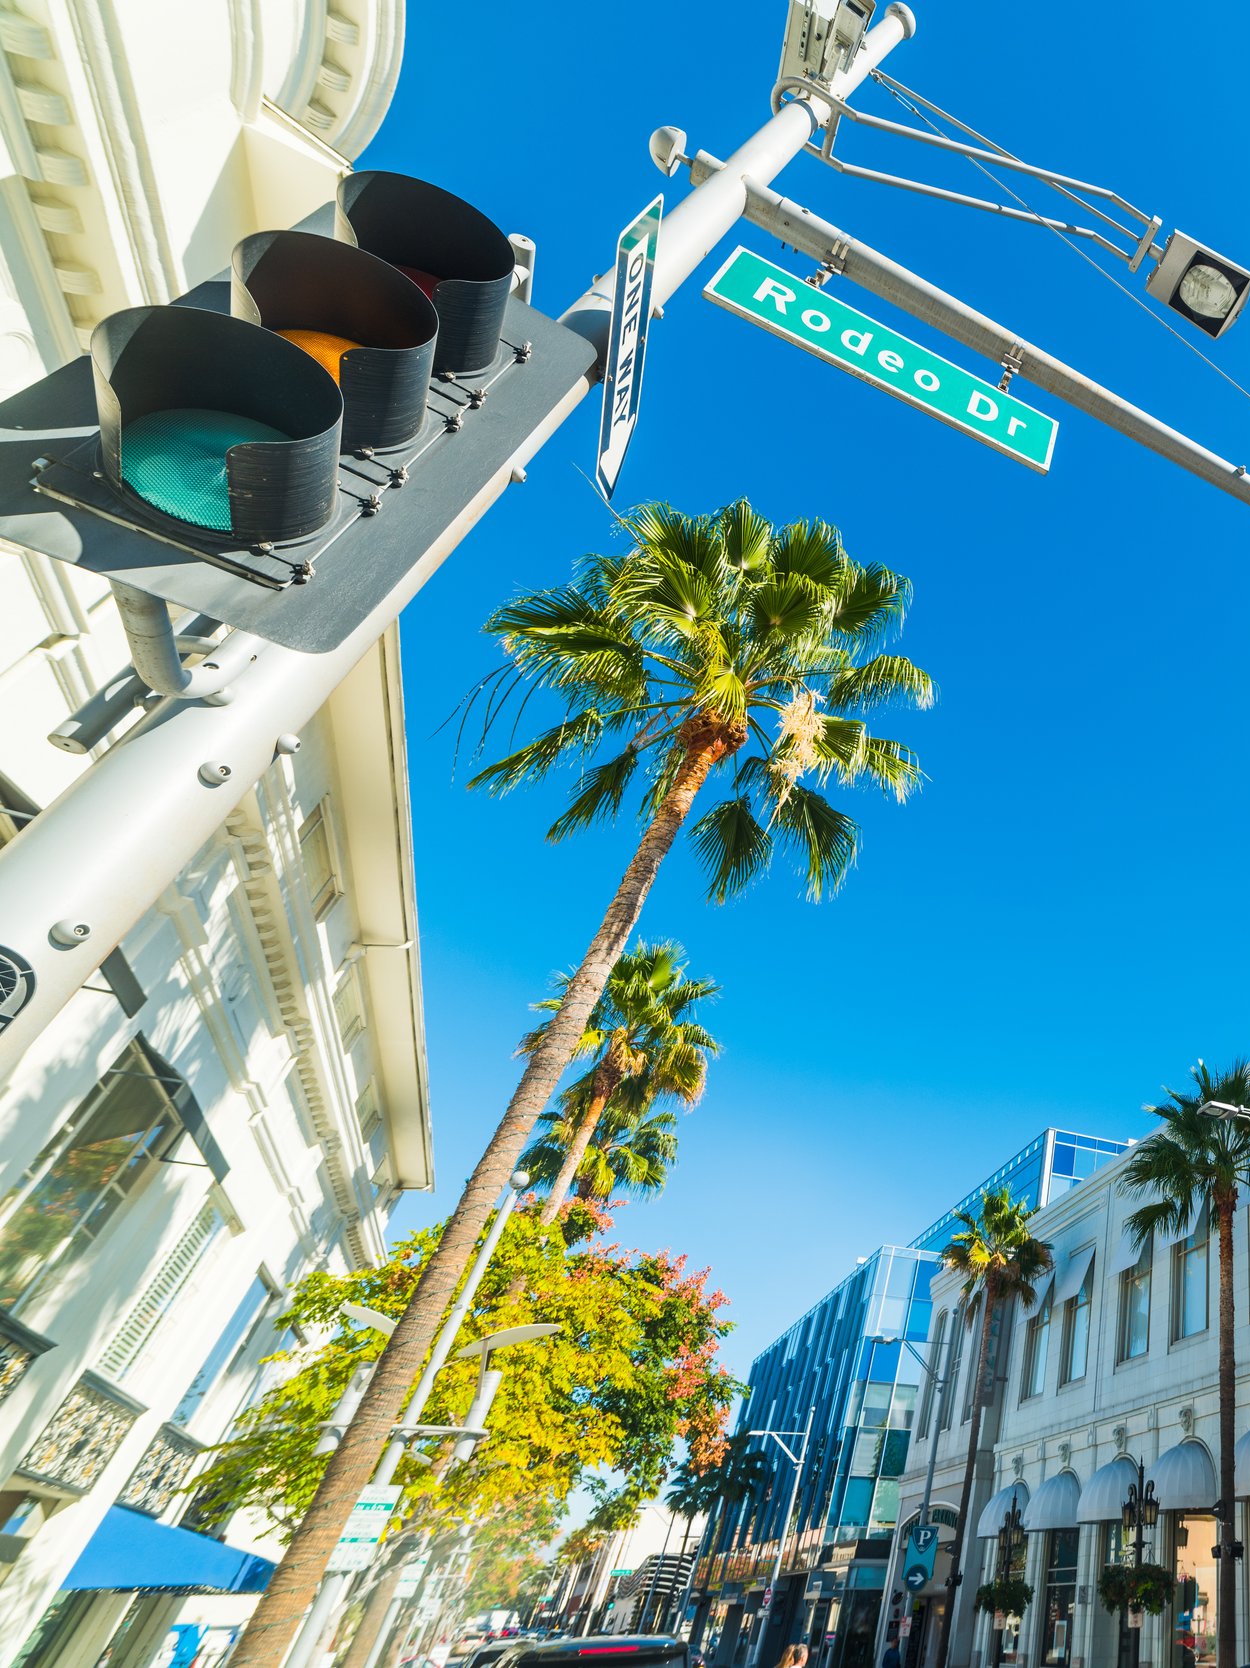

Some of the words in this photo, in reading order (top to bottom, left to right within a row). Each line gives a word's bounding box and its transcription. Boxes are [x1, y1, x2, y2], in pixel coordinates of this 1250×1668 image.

[622, 252, 645, 346] ONE
[613, 351, 635, 428] WAY
[752, 277, 941, 392] Rodeo
[965, 390, 1028, 438] Dr
[917, 1529, 932, 1546] P
